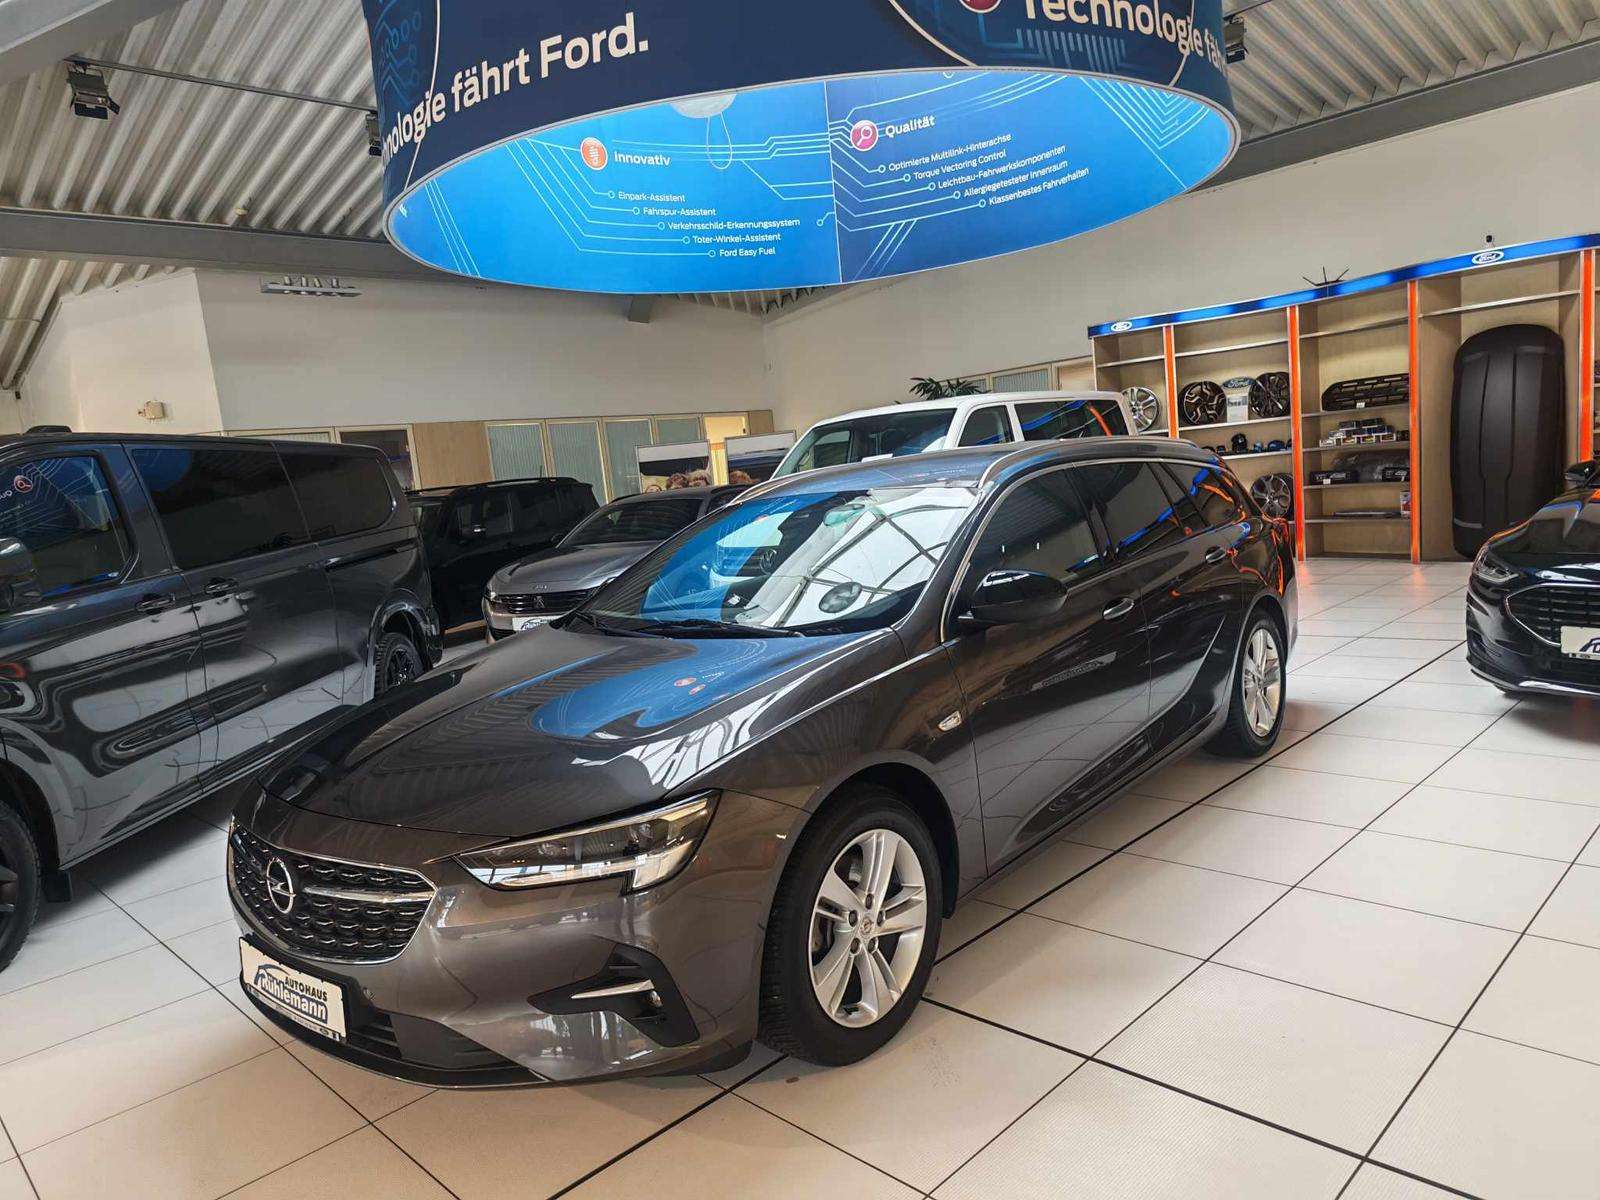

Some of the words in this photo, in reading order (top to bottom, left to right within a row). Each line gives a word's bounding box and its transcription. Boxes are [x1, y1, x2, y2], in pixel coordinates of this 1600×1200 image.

[451, 48, 531, 112] fährt
[540, 12, 649, 79] Ford.
[885, 115, 936, 138] Qualität
[614, 152, 671, 167] Innovativ
[888, 155, 930, 172] Optimierte
[930, 133, 1012, 162] Multilink-Hinterachse
[913, 168, 940, 182] Torque
[940, 158, 978, 175] Vectoring
[978, 149, 1007, 165] Control
[938, 145, 1066, 189] Leichtbau-Fahrwerkskomponenten
[964, 169, 1029, 198] Allergiegetesteter
[1029, 159, 1068, 181] Innenraum
[989, 184, 1042, 206] Klassenbestes
[1042, 167, 1090, 190] Fahrverhalten
[618, 191, 686, 203] Einpark-Assistent
[643, 207, 717, 217] Fahrspur-Assistent
[668, 219, 801, 231] Verkehrsschild-Erkennungssystem
[693, 233, 781, 244] Toter-Winkel-Assistent
[719, 249, 738, 257] Ford
[739, 248, 757, 258] Easy
[758, 247, 776, 256] Fuel
[284, 976, 328, 1002] AUTOHAUS
